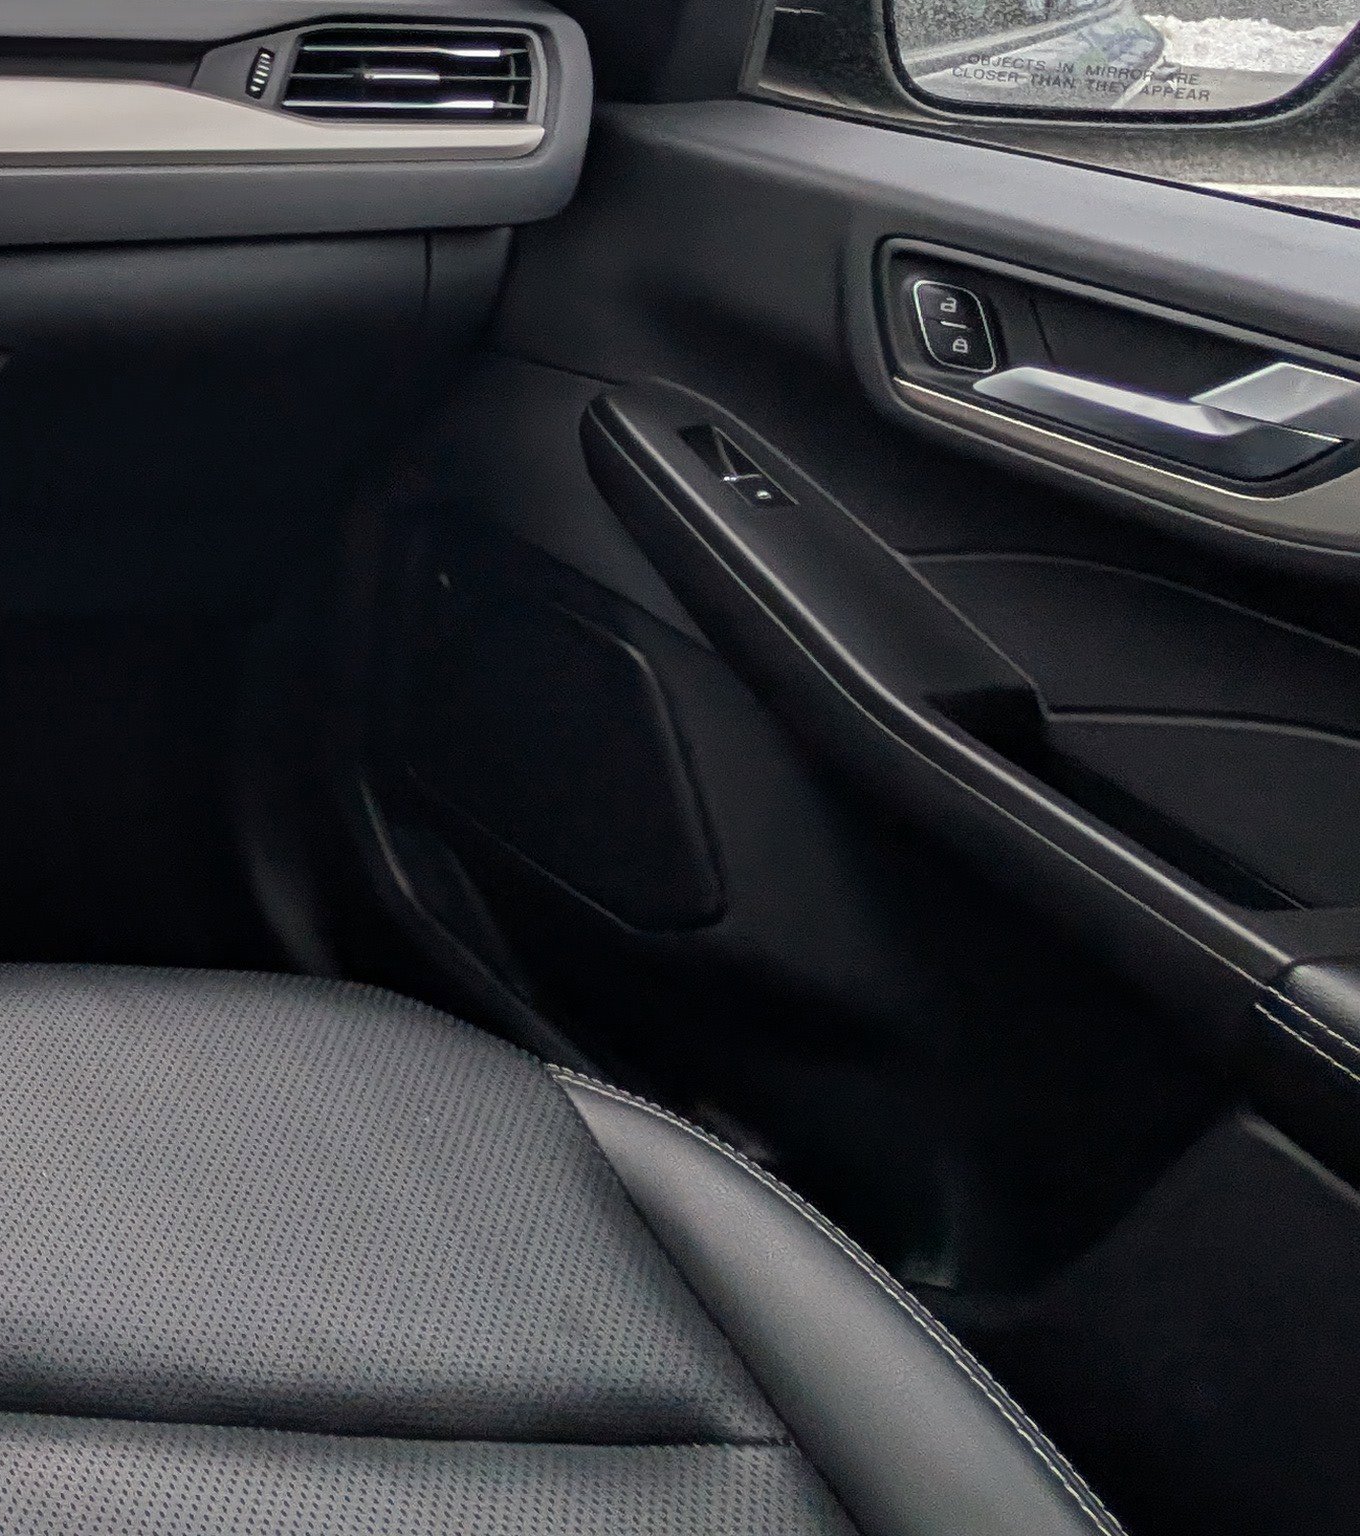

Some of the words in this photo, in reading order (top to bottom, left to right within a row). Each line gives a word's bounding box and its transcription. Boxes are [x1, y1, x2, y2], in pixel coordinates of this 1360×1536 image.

[951, 66, 1019, 83] CLOSER
[1030, 73, 1077, 89] THAN
[1084, 78, 1130, 94] THEY
[1140, 84, 1211, 102] APPEAR
[968, 54, 1046, 72] OBJECTS
[1057, 62, 1074, 74] IN
[1084, 64, 1155, 82] MIRROR
